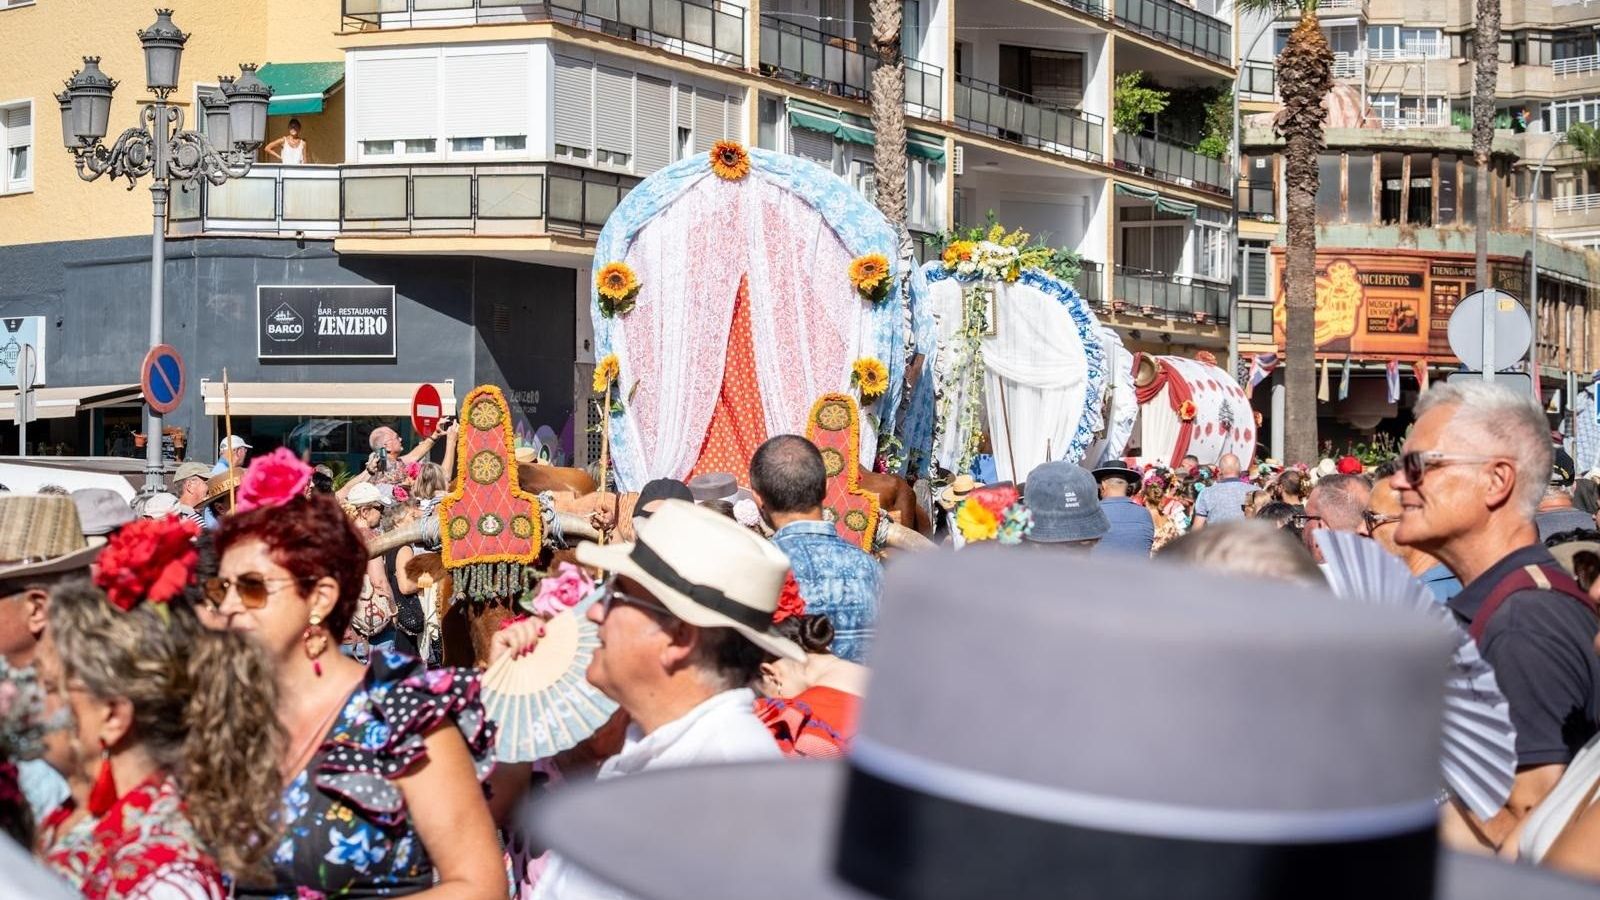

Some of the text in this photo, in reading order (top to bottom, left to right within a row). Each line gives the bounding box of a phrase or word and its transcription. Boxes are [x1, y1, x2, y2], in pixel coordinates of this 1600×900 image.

[1432, 266, 1459, 275] TIENDA
[1357, 273, 1410, 286] ONCIERTOS
[268, 324, 302, 334] BARCO
[318, 316, 388, 335] ZENZERO
